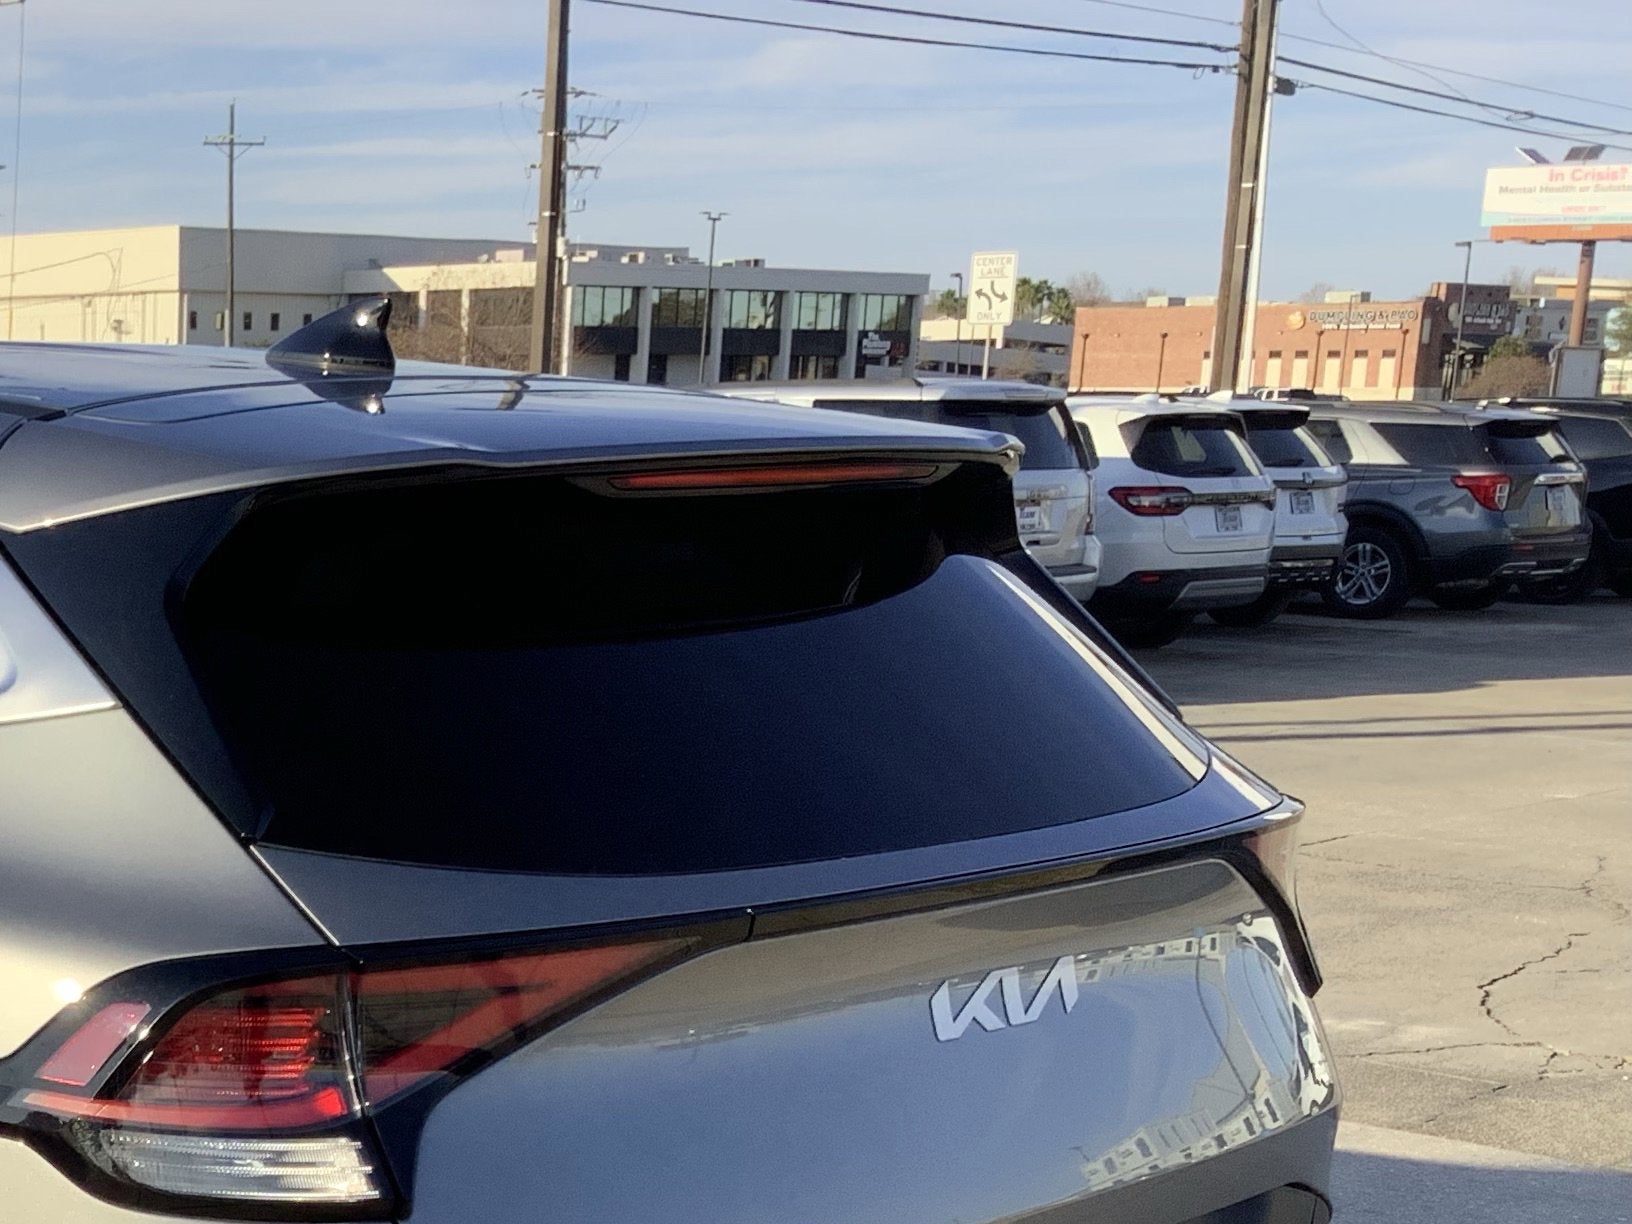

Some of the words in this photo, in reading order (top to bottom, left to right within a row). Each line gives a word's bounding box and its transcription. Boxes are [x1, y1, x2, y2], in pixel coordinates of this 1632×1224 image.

[976, 256, 1013, 267] CENTER
[981, 267, 1005, 276] LANE
[977, 312, 1002, 321] ONLY
